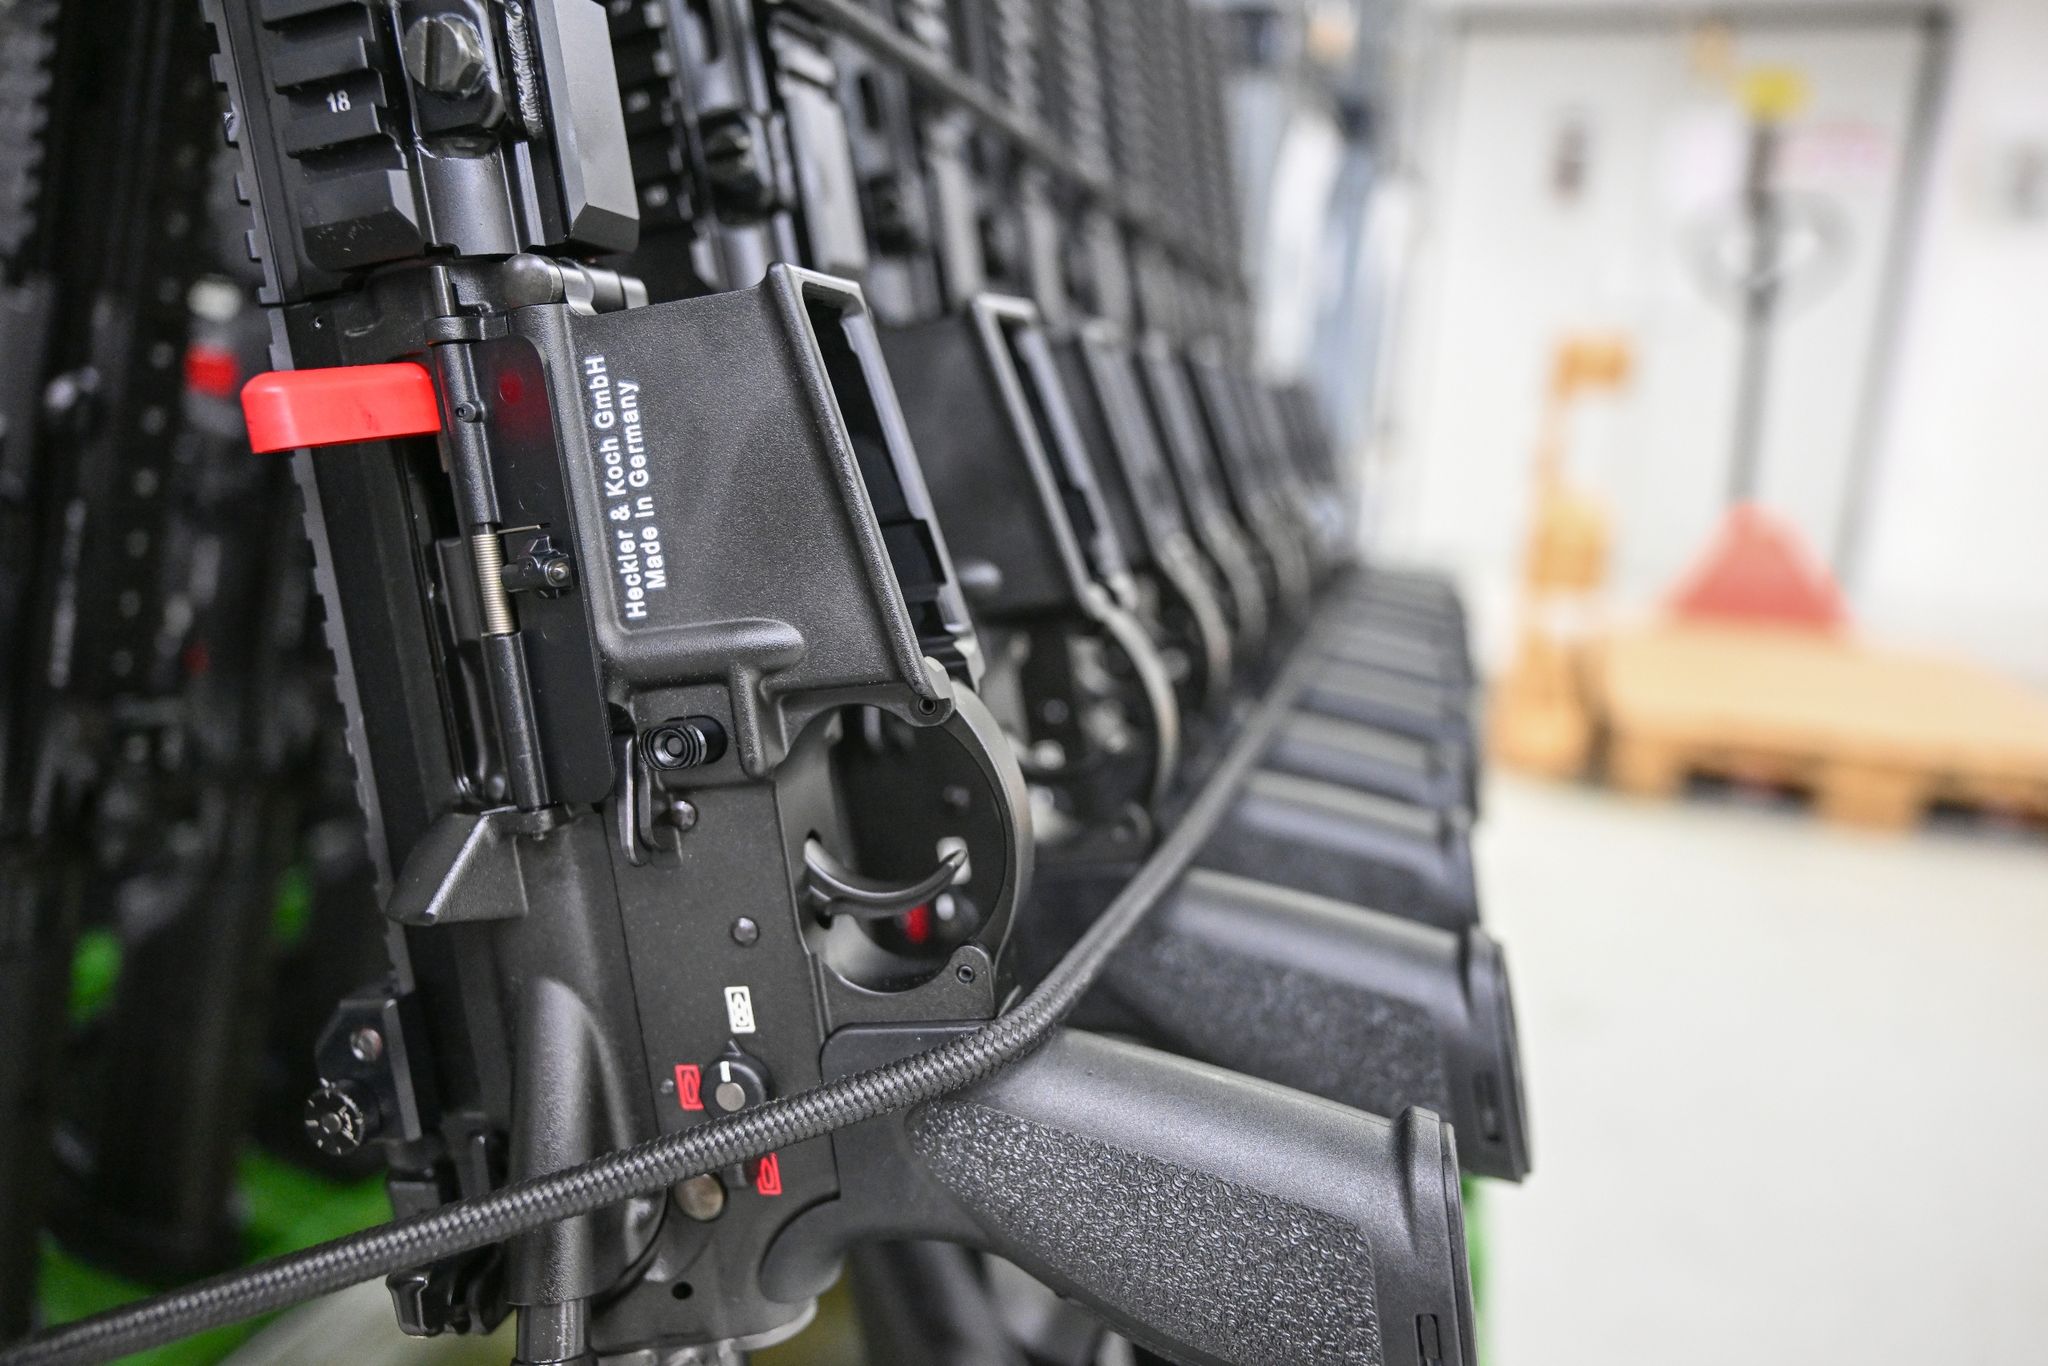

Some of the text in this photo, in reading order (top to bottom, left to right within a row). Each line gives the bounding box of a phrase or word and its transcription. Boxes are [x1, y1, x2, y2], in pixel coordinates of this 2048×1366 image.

[326, 90, 351, 113] 18
[617, 381, 650, 488] Germany
[585, 356, 647, 619] Heckler & Koch GmbH
[640, 527, 667, 590] Made
